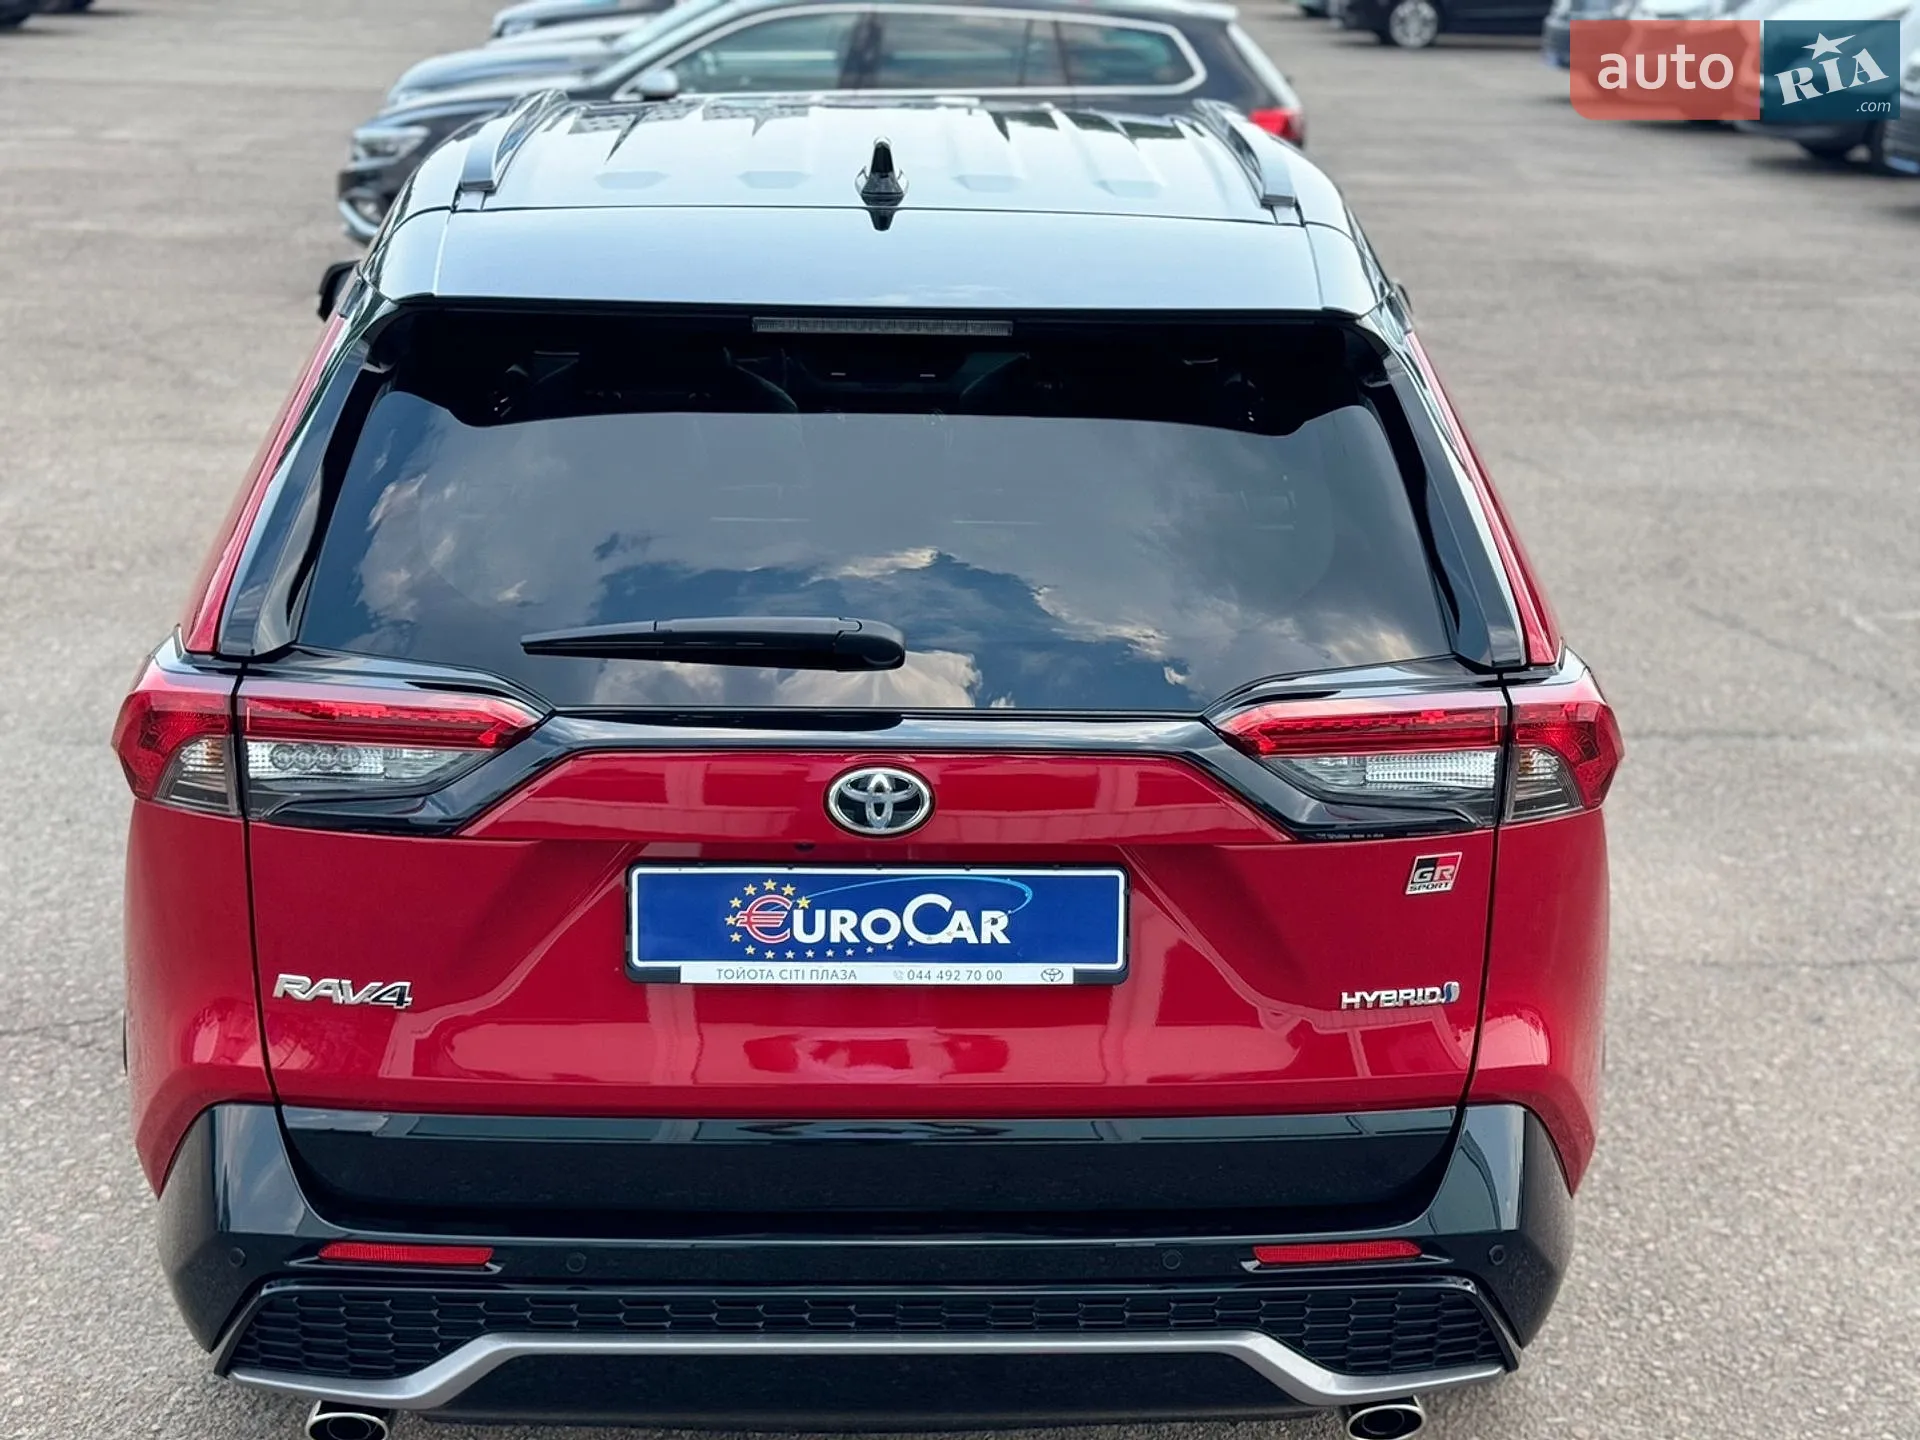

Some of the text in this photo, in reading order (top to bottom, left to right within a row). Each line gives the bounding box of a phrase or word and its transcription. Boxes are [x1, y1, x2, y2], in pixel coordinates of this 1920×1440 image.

[1414, 865, 1455, 883] GR
[1408, 882, 1449, 892] SPORT
[716, 967, 774, 981] ТОЙОТА
[810, 969, 857, 981] ПЛАЗА
[907, 969, 1003, 981] 044 492 70 00
[272, 973, 413, 1010] RAV4
[1341, 986, 1442, 1010] HYBRID
